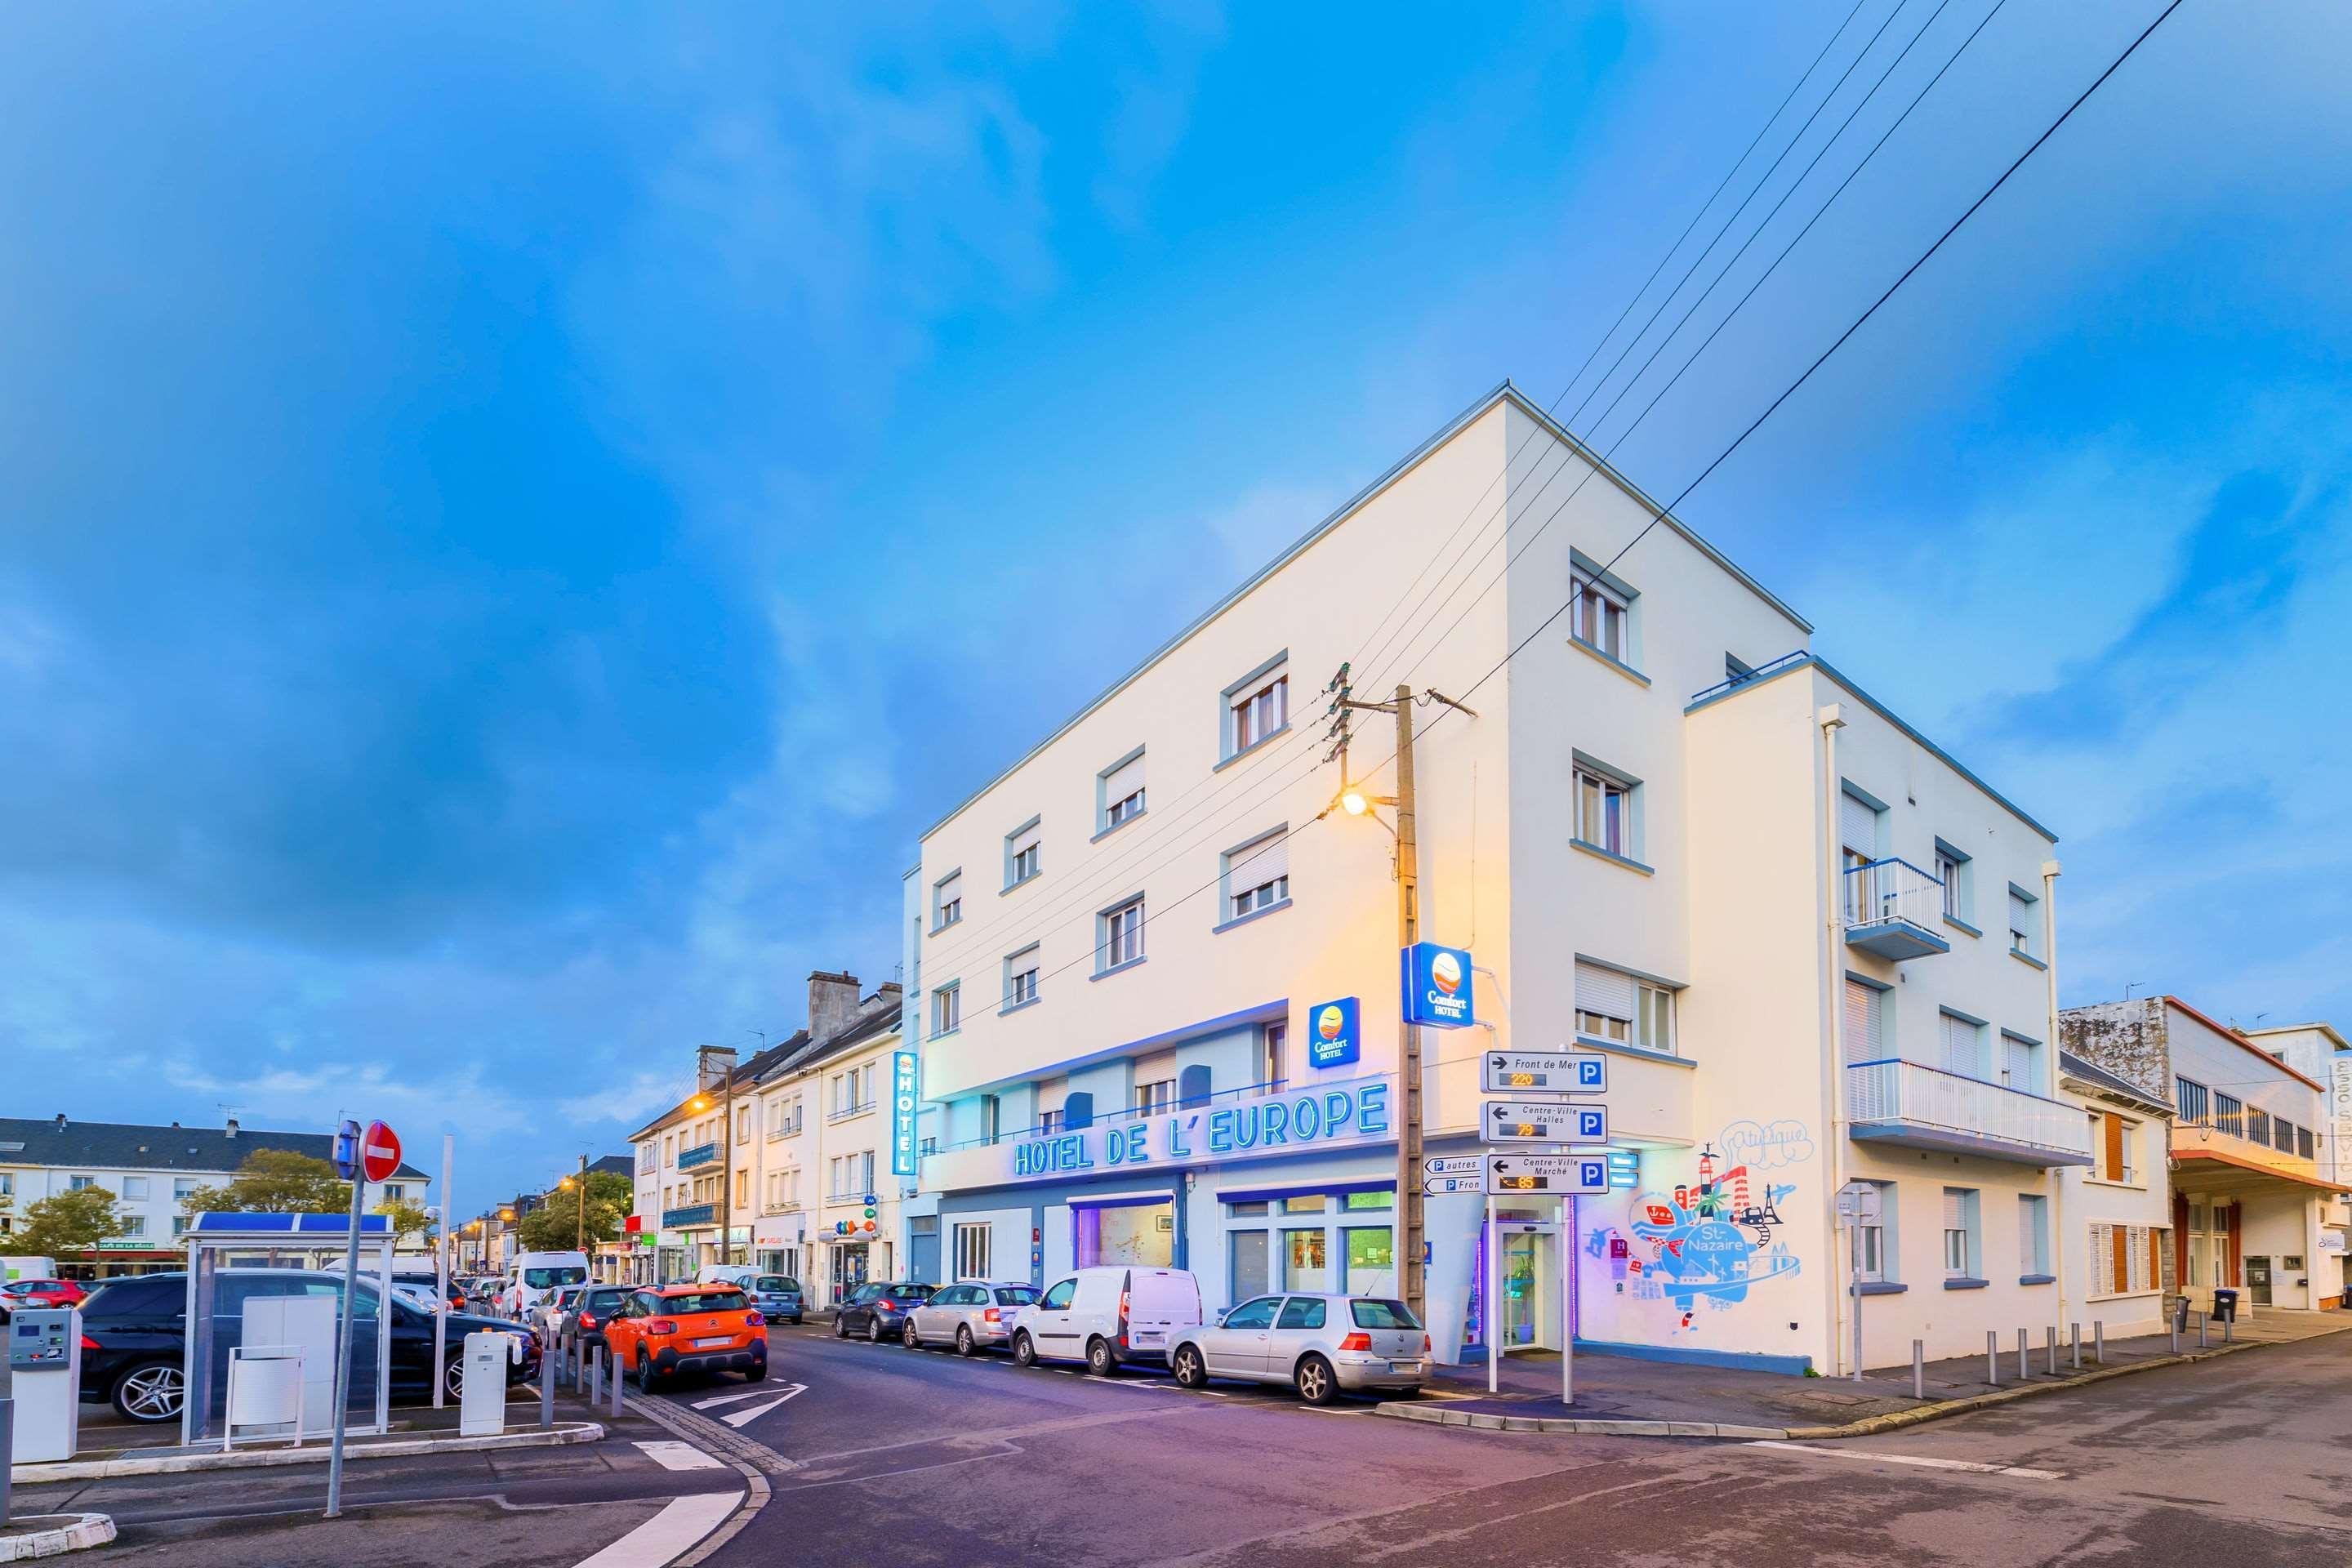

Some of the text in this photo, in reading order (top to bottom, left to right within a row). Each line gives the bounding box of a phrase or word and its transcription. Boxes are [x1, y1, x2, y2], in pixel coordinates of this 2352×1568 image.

[1428, 990, 1467, 1009] Comfort
[1435, 1005, 1462, 1018] HOTEL
[1314, 1038, 1348, 1053] Comfort
[1320, 1049, 1343, 1060] HOTEL
[1515, 1058, 1577, 1070] Front de Mer
[1511, 1073, 1533, 1085] 220
[1584, 1064, 1597, 1082] P
[1522, 1106, 1578, 1116] Centre-Ville
[898, 1076, 914, 1172] HOTEL
[1536, 1115, 1564, 1124] Halles
[1584, 1115, 1597, 1133] P
[1014, 1134, 1094, 1176] HOTEL
[1107, 1124, 1148, 1165] DE
[1446, 1161, 1477, 1169] autres
[1523, 1158, 1579, 1166] Centre-Ville
[1535, 1167, 1567, 1175] Marché
[1586, 1165, 1599, 1183] P
[1459, 1180, 1480, 1189] Fron
[1518, 1176, 1534, 1188] 85
[1688, 1238, 1744, 1251] Nazaire
